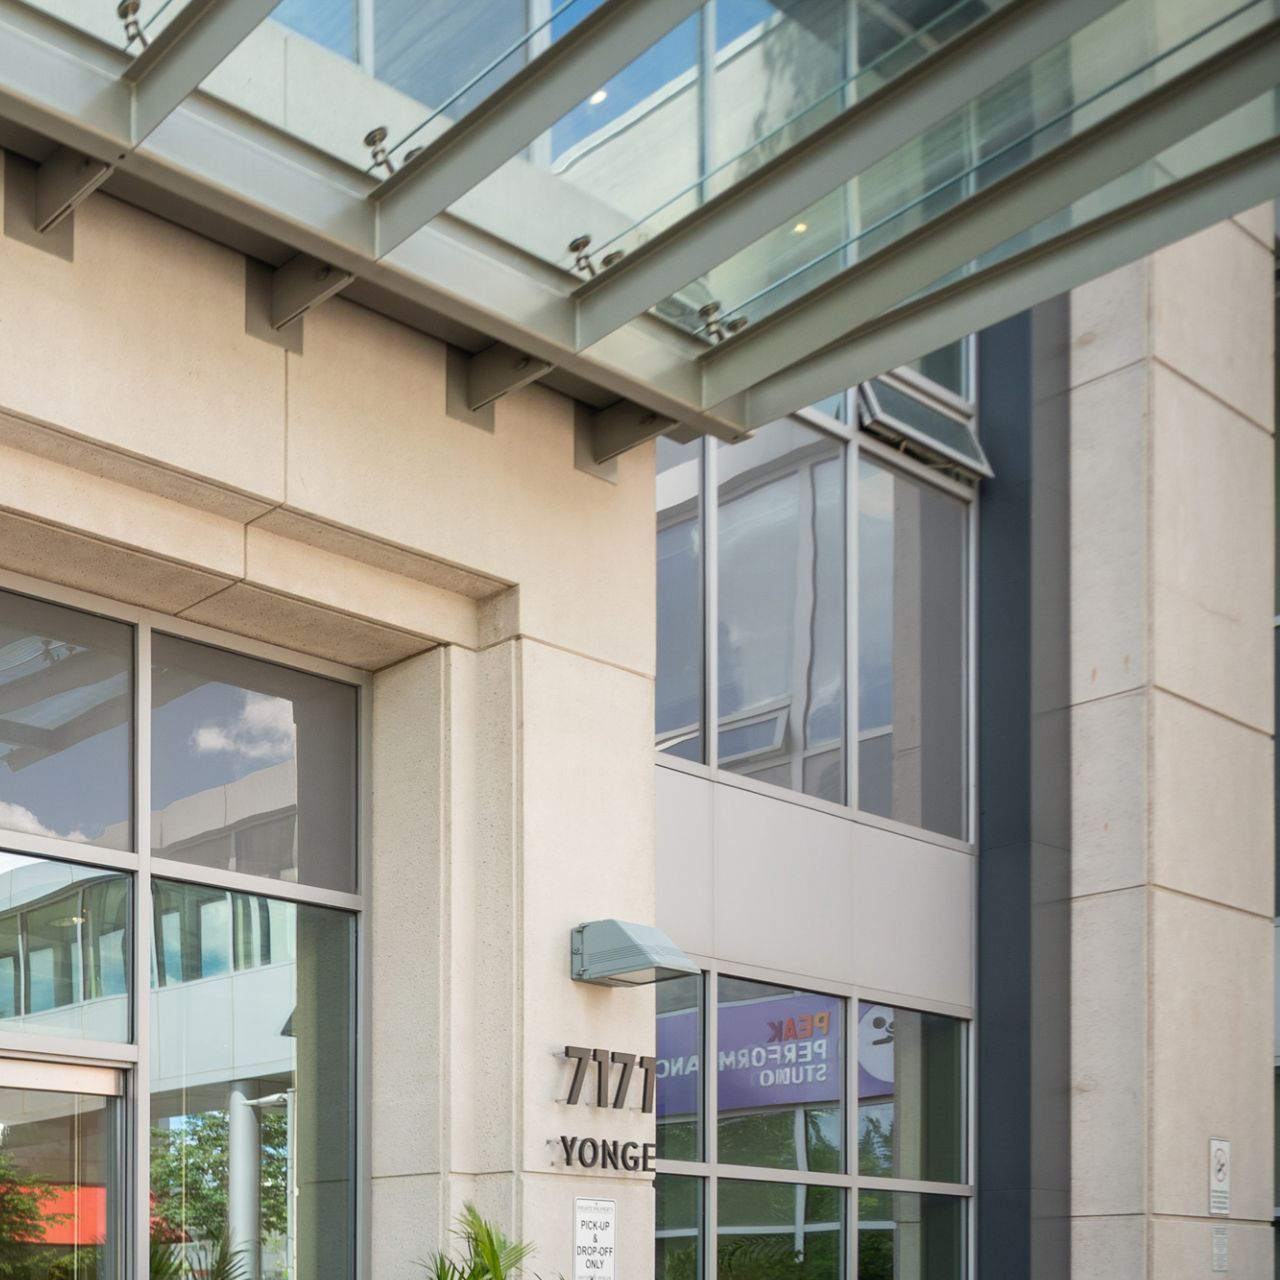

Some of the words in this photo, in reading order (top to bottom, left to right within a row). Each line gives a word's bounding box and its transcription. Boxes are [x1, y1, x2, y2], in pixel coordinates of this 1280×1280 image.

[565, 1046, 656, 1113] 7171
[560, 1135, 656, 1172] YONGE
[580, 1220, 610, 1231] PICK-UP
[576, 1246, 614, 1256] DROP-OFF
[585, 1258, 604, 1269] ONLY
